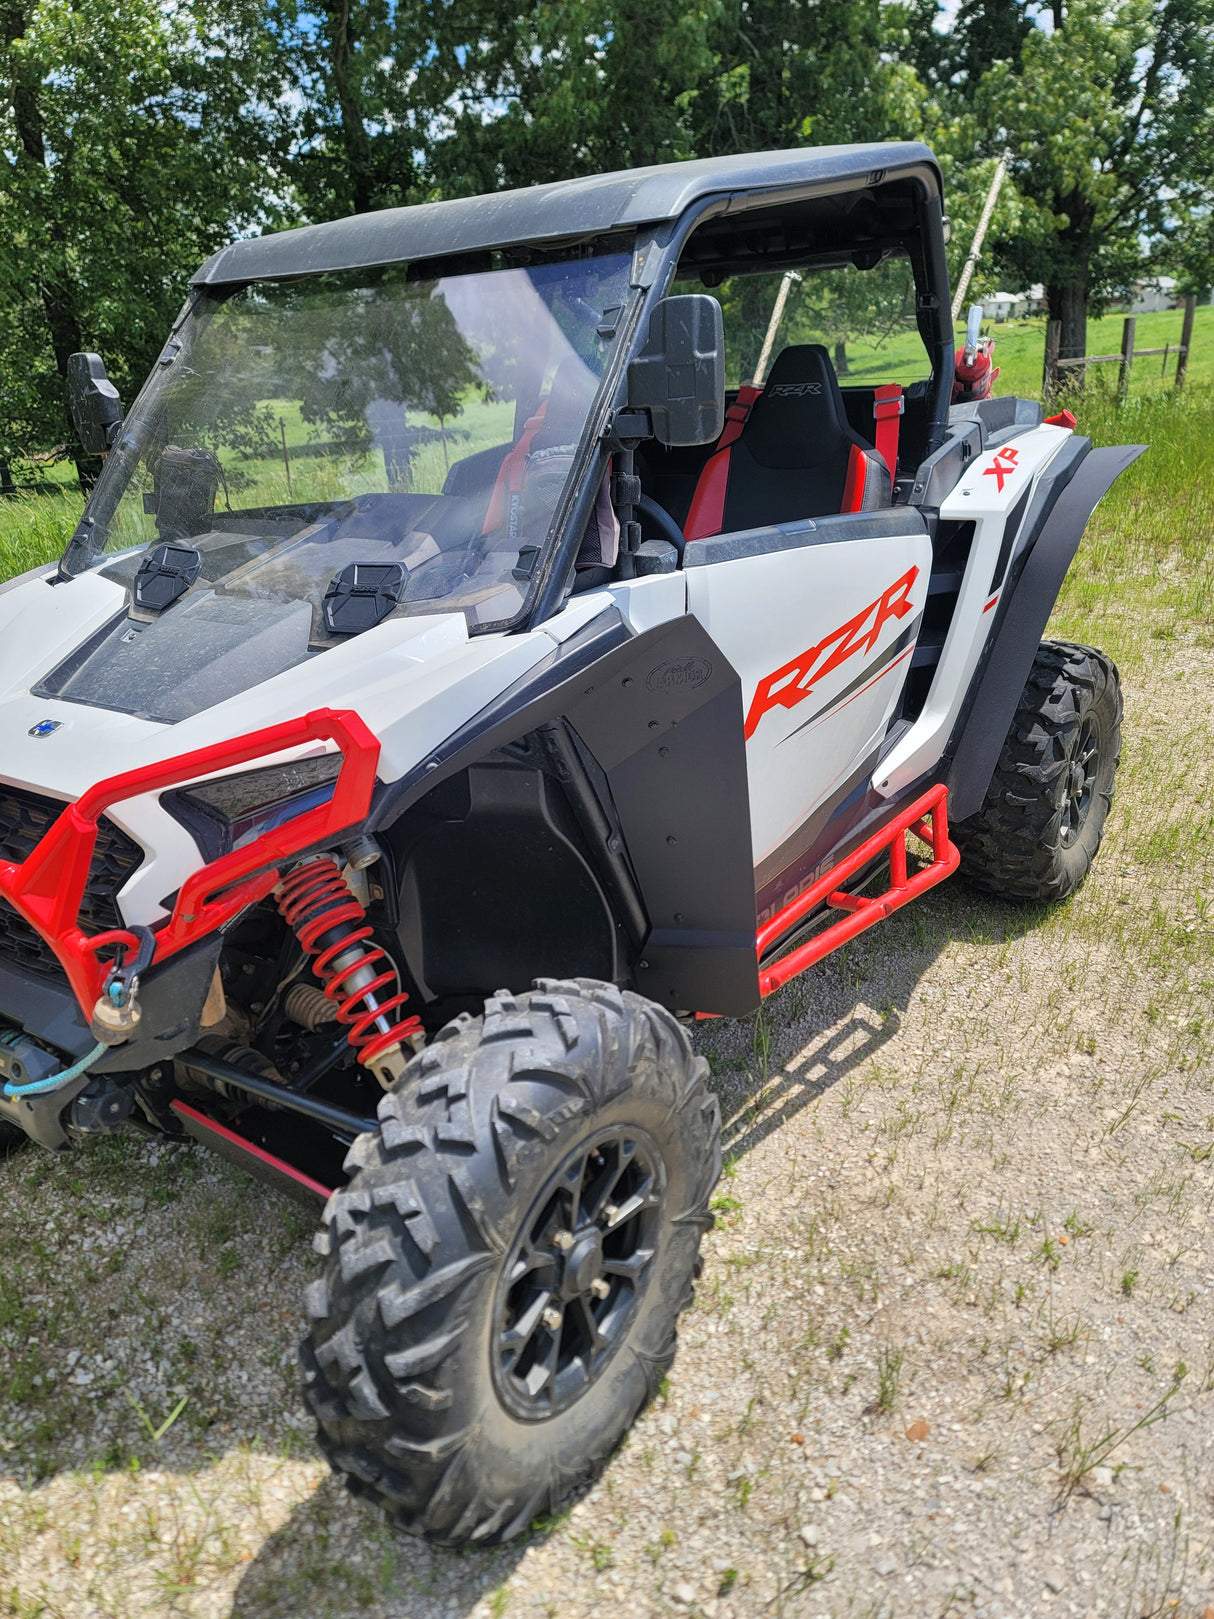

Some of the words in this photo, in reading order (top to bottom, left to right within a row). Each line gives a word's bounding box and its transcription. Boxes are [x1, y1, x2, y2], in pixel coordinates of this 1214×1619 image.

[768, 382, 822, 398] RZR
[983, 447, 1019, 494] XP
[744, 565, 920, 742] RZR
